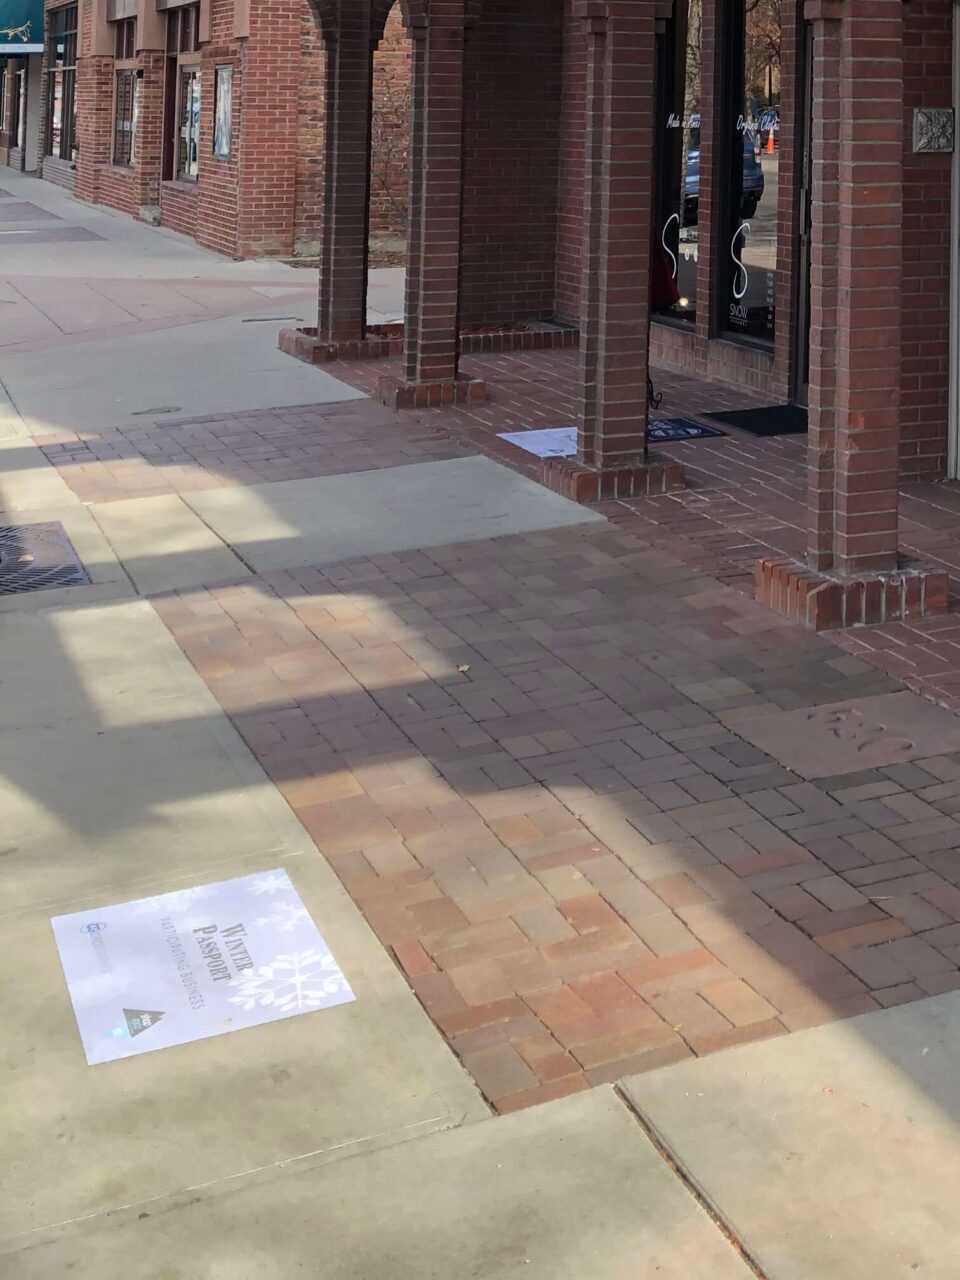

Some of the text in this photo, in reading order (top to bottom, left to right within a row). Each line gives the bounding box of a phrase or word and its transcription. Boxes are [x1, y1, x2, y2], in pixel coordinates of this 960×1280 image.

[729, 303, 749, 319] SNOW
[192, 923, 233, 983] PASSPORT
[220, 922, 254, 972] WINTER
